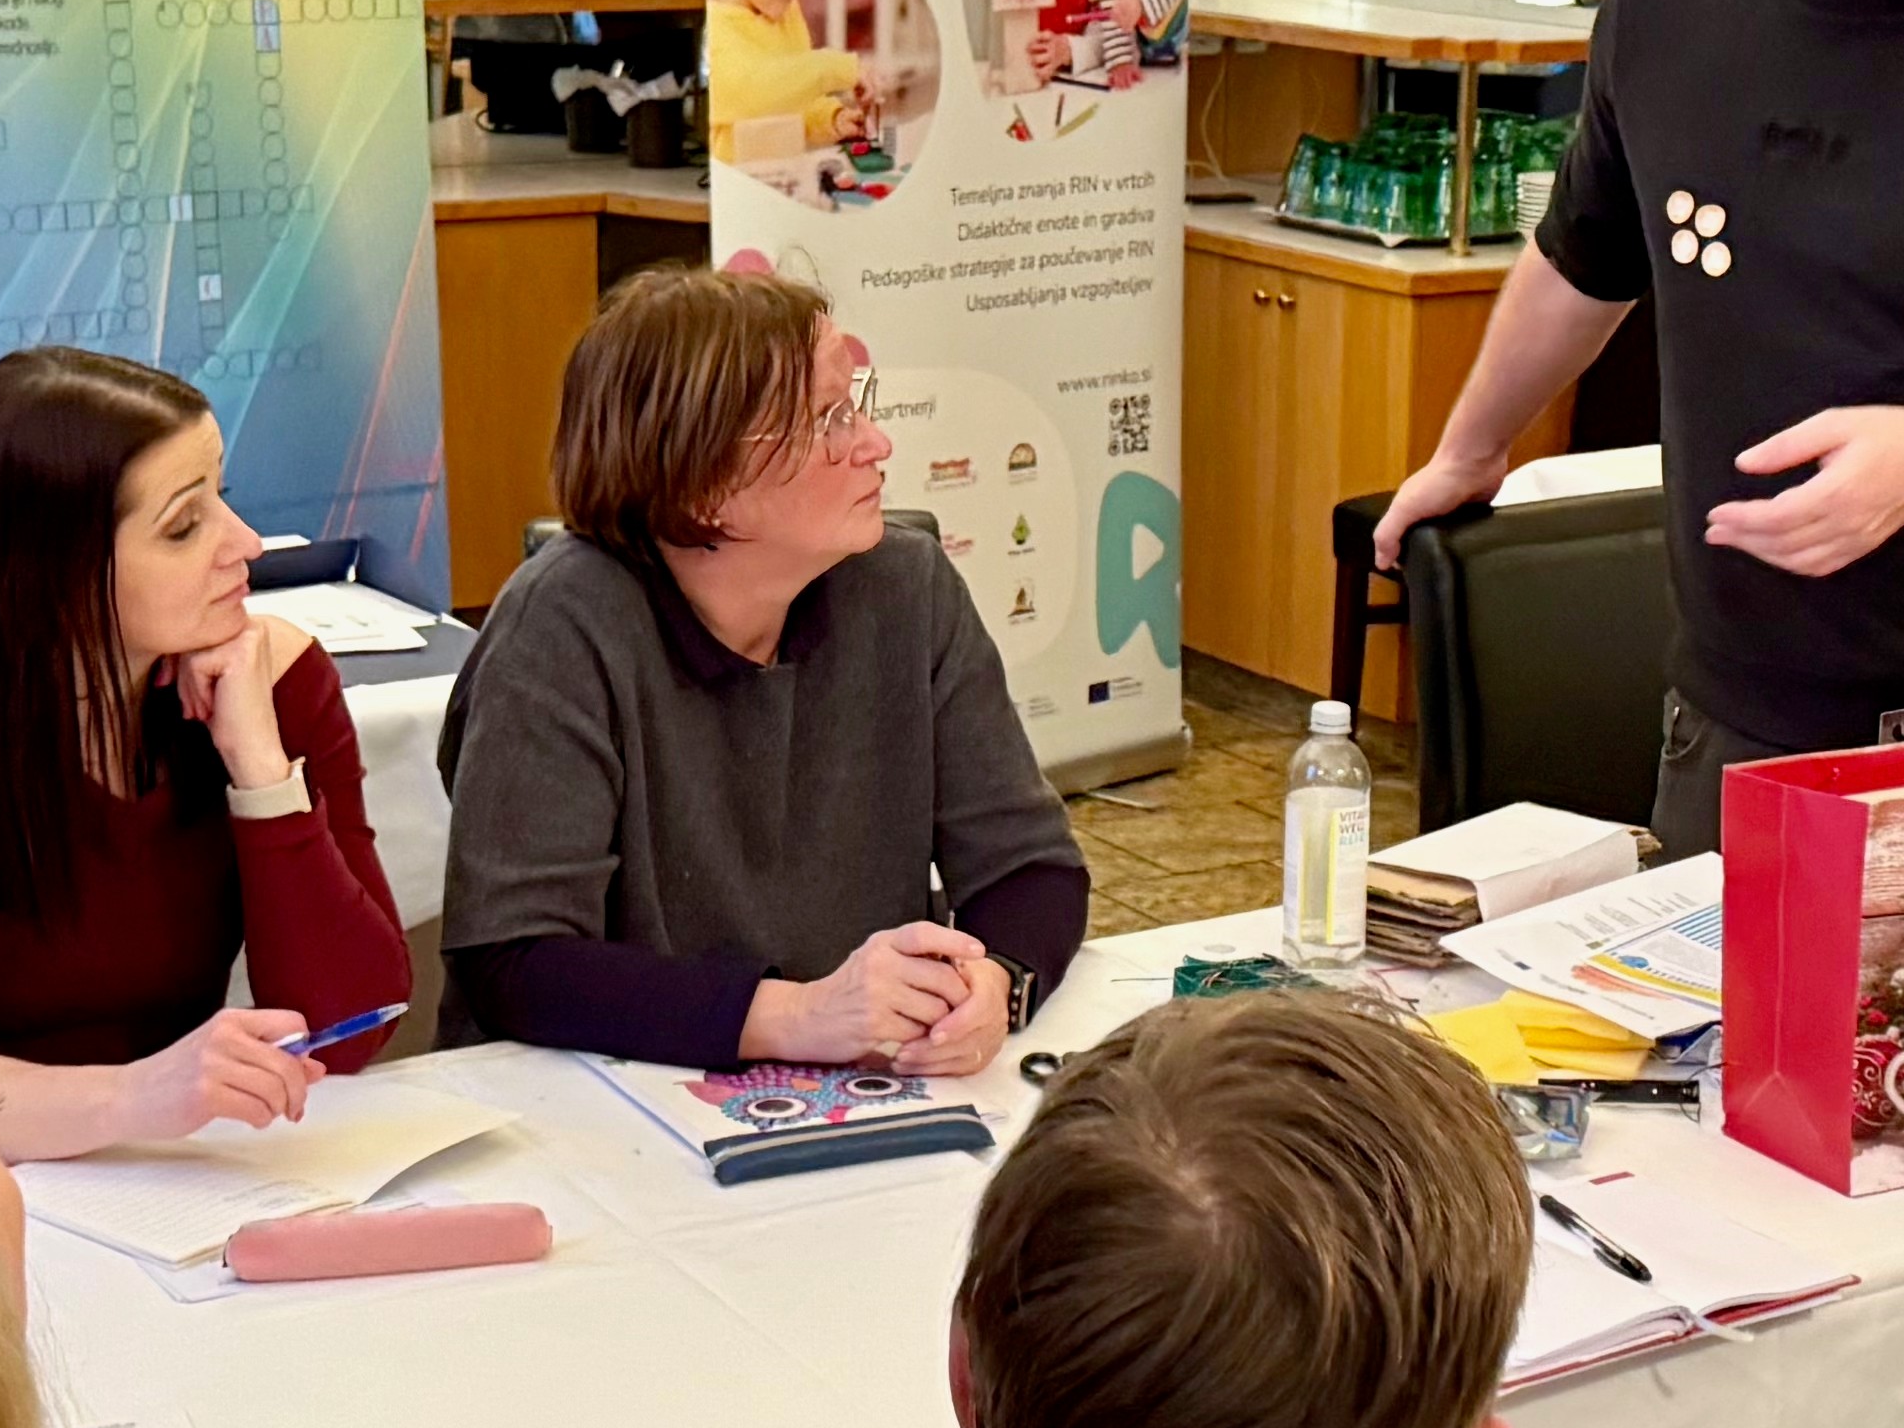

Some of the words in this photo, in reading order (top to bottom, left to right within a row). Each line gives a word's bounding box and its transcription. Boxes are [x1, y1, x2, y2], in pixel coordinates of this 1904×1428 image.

[950, 184, 1015, 207] Temeljna
[1017, 180, 1066, 200] znanja
[1070, 175, 1099, 194] RIN
[1102, 177, 1112, 192] v
[957, 217, 1032, 242] Didaktične
[1036, 214, 1080, 233] enote
[1082, 212, 1098, 228] in
[1100, 207, 1156, 232] gradiva
[861, 263, 946, 288] Pedagoške
[949, 256, 1017, 280] strategije
[1019, 255, 1035, 270] za
[1038, 246, 1125, 270] poučevanje
[1128, 239, 1155, 259] RIN
[966, 282, 1067, 312] Usposabljanja
[1070, 276, 1153, 300] vzgojiteljev
